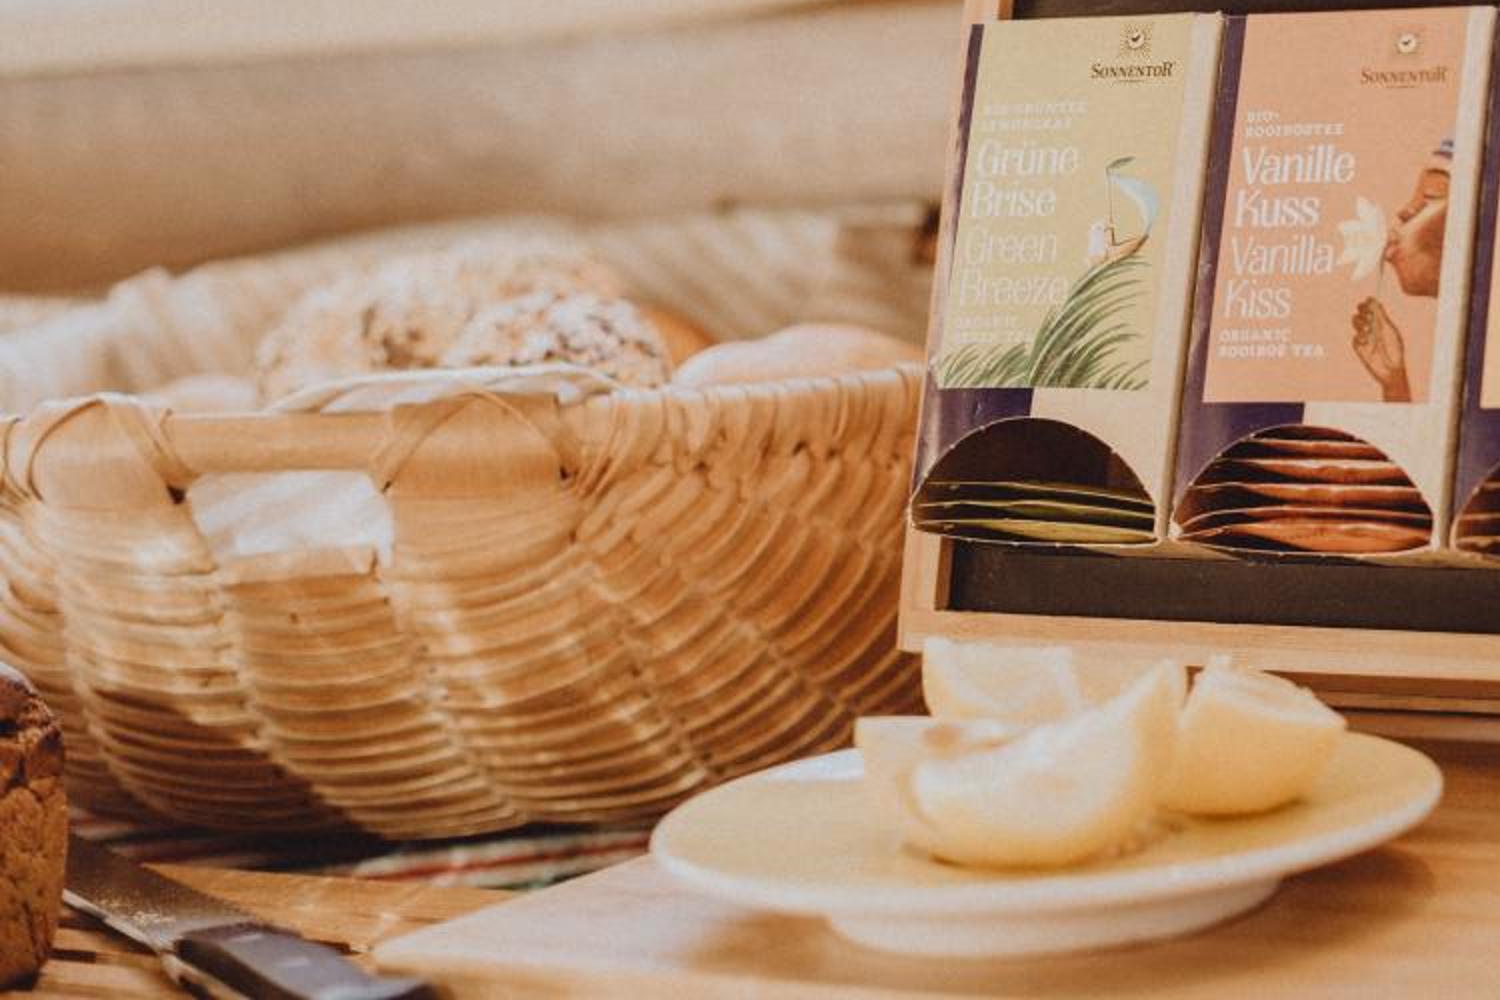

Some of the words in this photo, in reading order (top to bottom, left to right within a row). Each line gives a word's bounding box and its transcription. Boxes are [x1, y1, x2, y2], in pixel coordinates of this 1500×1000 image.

[1091, 61, 1175, 79] SONNENTOR
[1360, 66, 1448, 85] SONNENTOR
[977, 139, 1079, 180] Grüne
[1241, 143, 1356, 185] Vanille
[971, 181, 1057, 217] Brise
[1232, 187, 1320, 229] Kuss
[1231, 234, 1335, 275] Vanilla
[1221, 279, 1292, 318] Kiss
